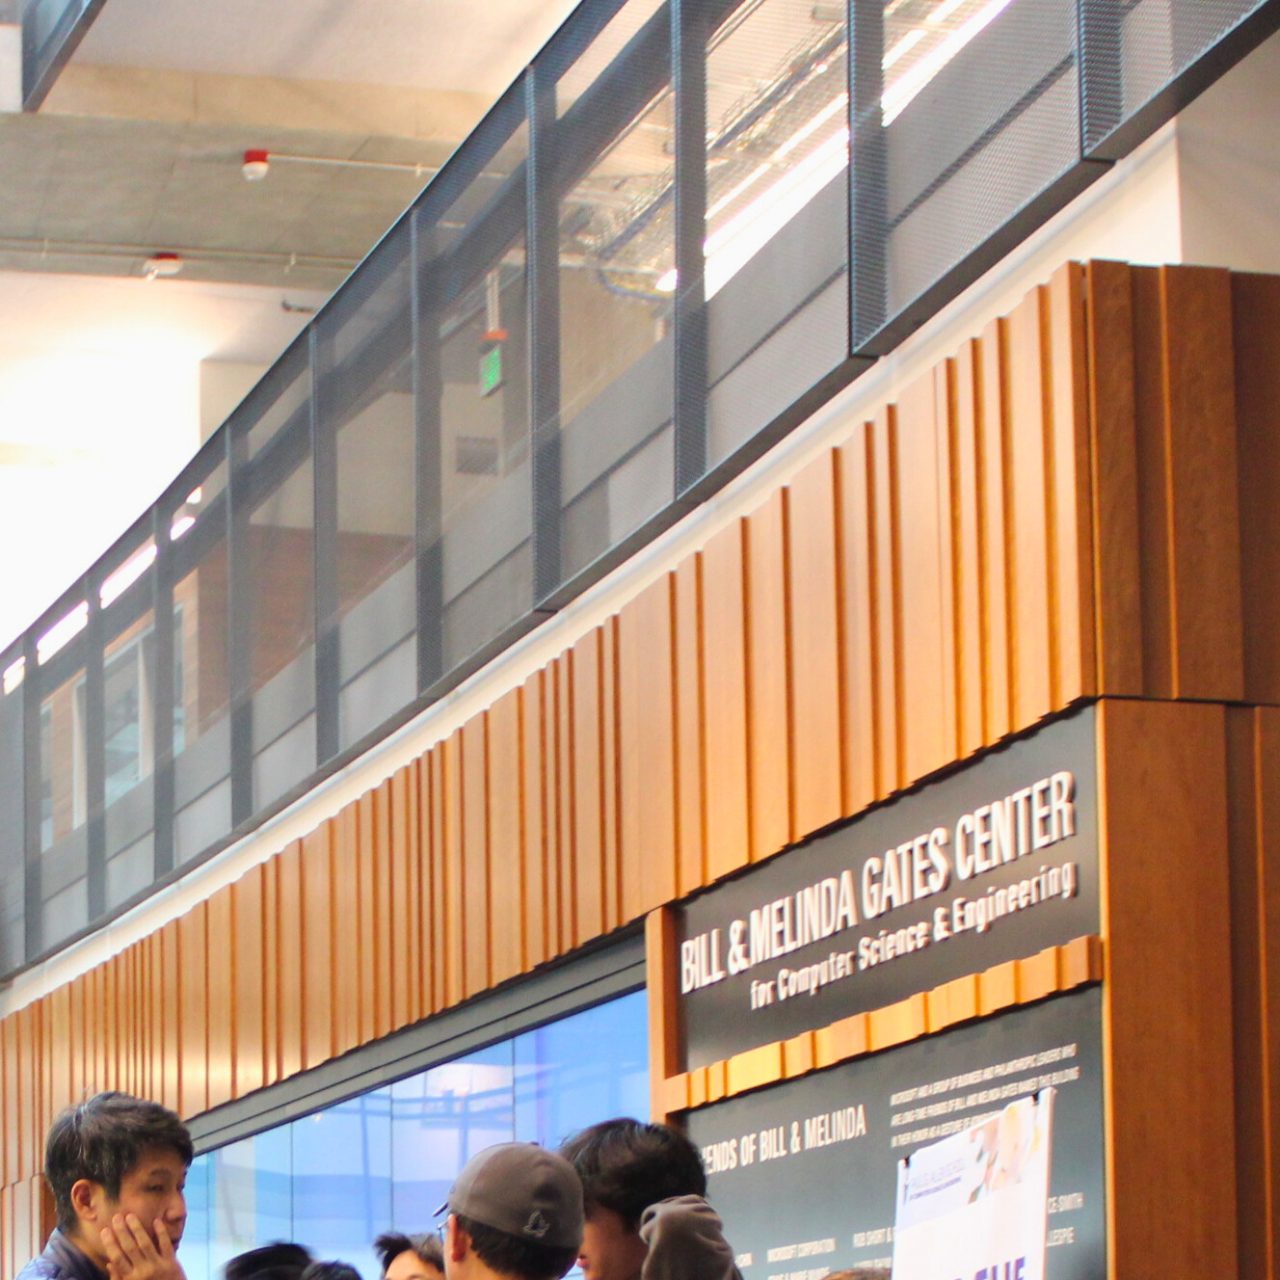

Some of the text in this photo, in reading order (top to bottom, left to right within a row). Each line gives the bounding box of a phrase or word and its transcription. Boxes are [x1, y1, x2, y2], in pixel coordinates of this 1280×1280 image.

[682, 771, 1075, 994] BILL & MELINDA GATES CENTER
[751, 862, 1077, 1010] for Computer Science & Engineering
[740, 1132, 757, 1166] OF
[759, 1126, 787, 1162] BILL
[790, 1121, 801, 1154] &
[805, 1104, 866, 1149] MELINDA
